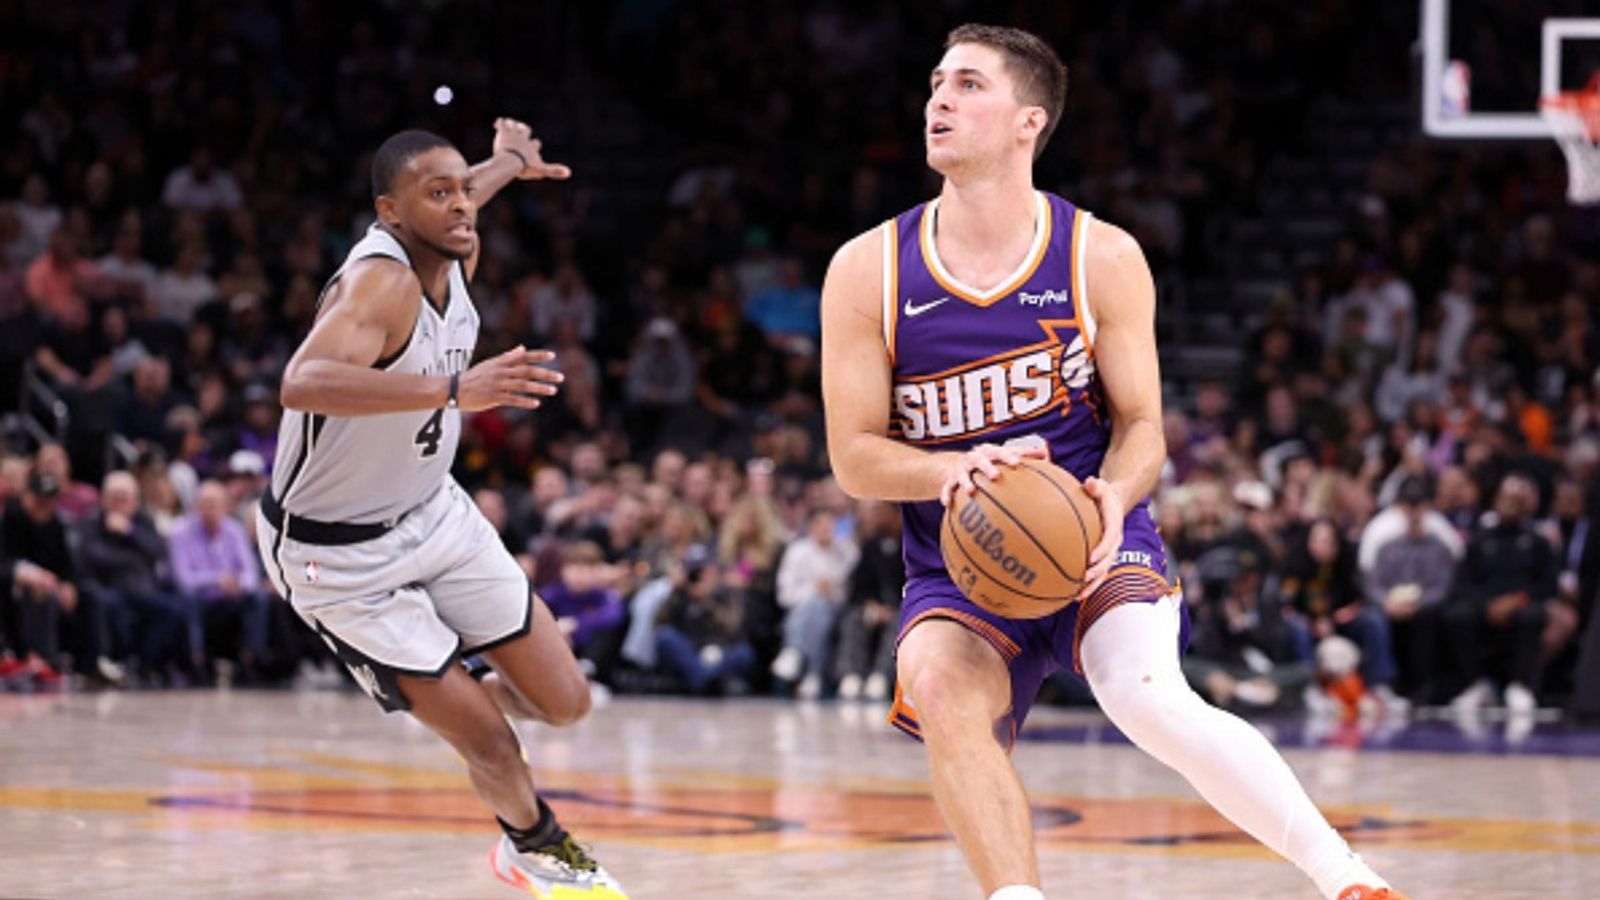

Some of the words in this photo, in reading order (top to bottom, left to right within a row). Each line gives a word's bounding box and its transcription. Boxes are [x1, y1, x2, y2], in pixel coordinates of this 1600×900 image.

[1018, 289, 1067, 307] PayPal
[895, 349, 1052, 440] SUNS
[414, 406, 444, 458] 4
[958, 498, 1037, 588] Wilson
